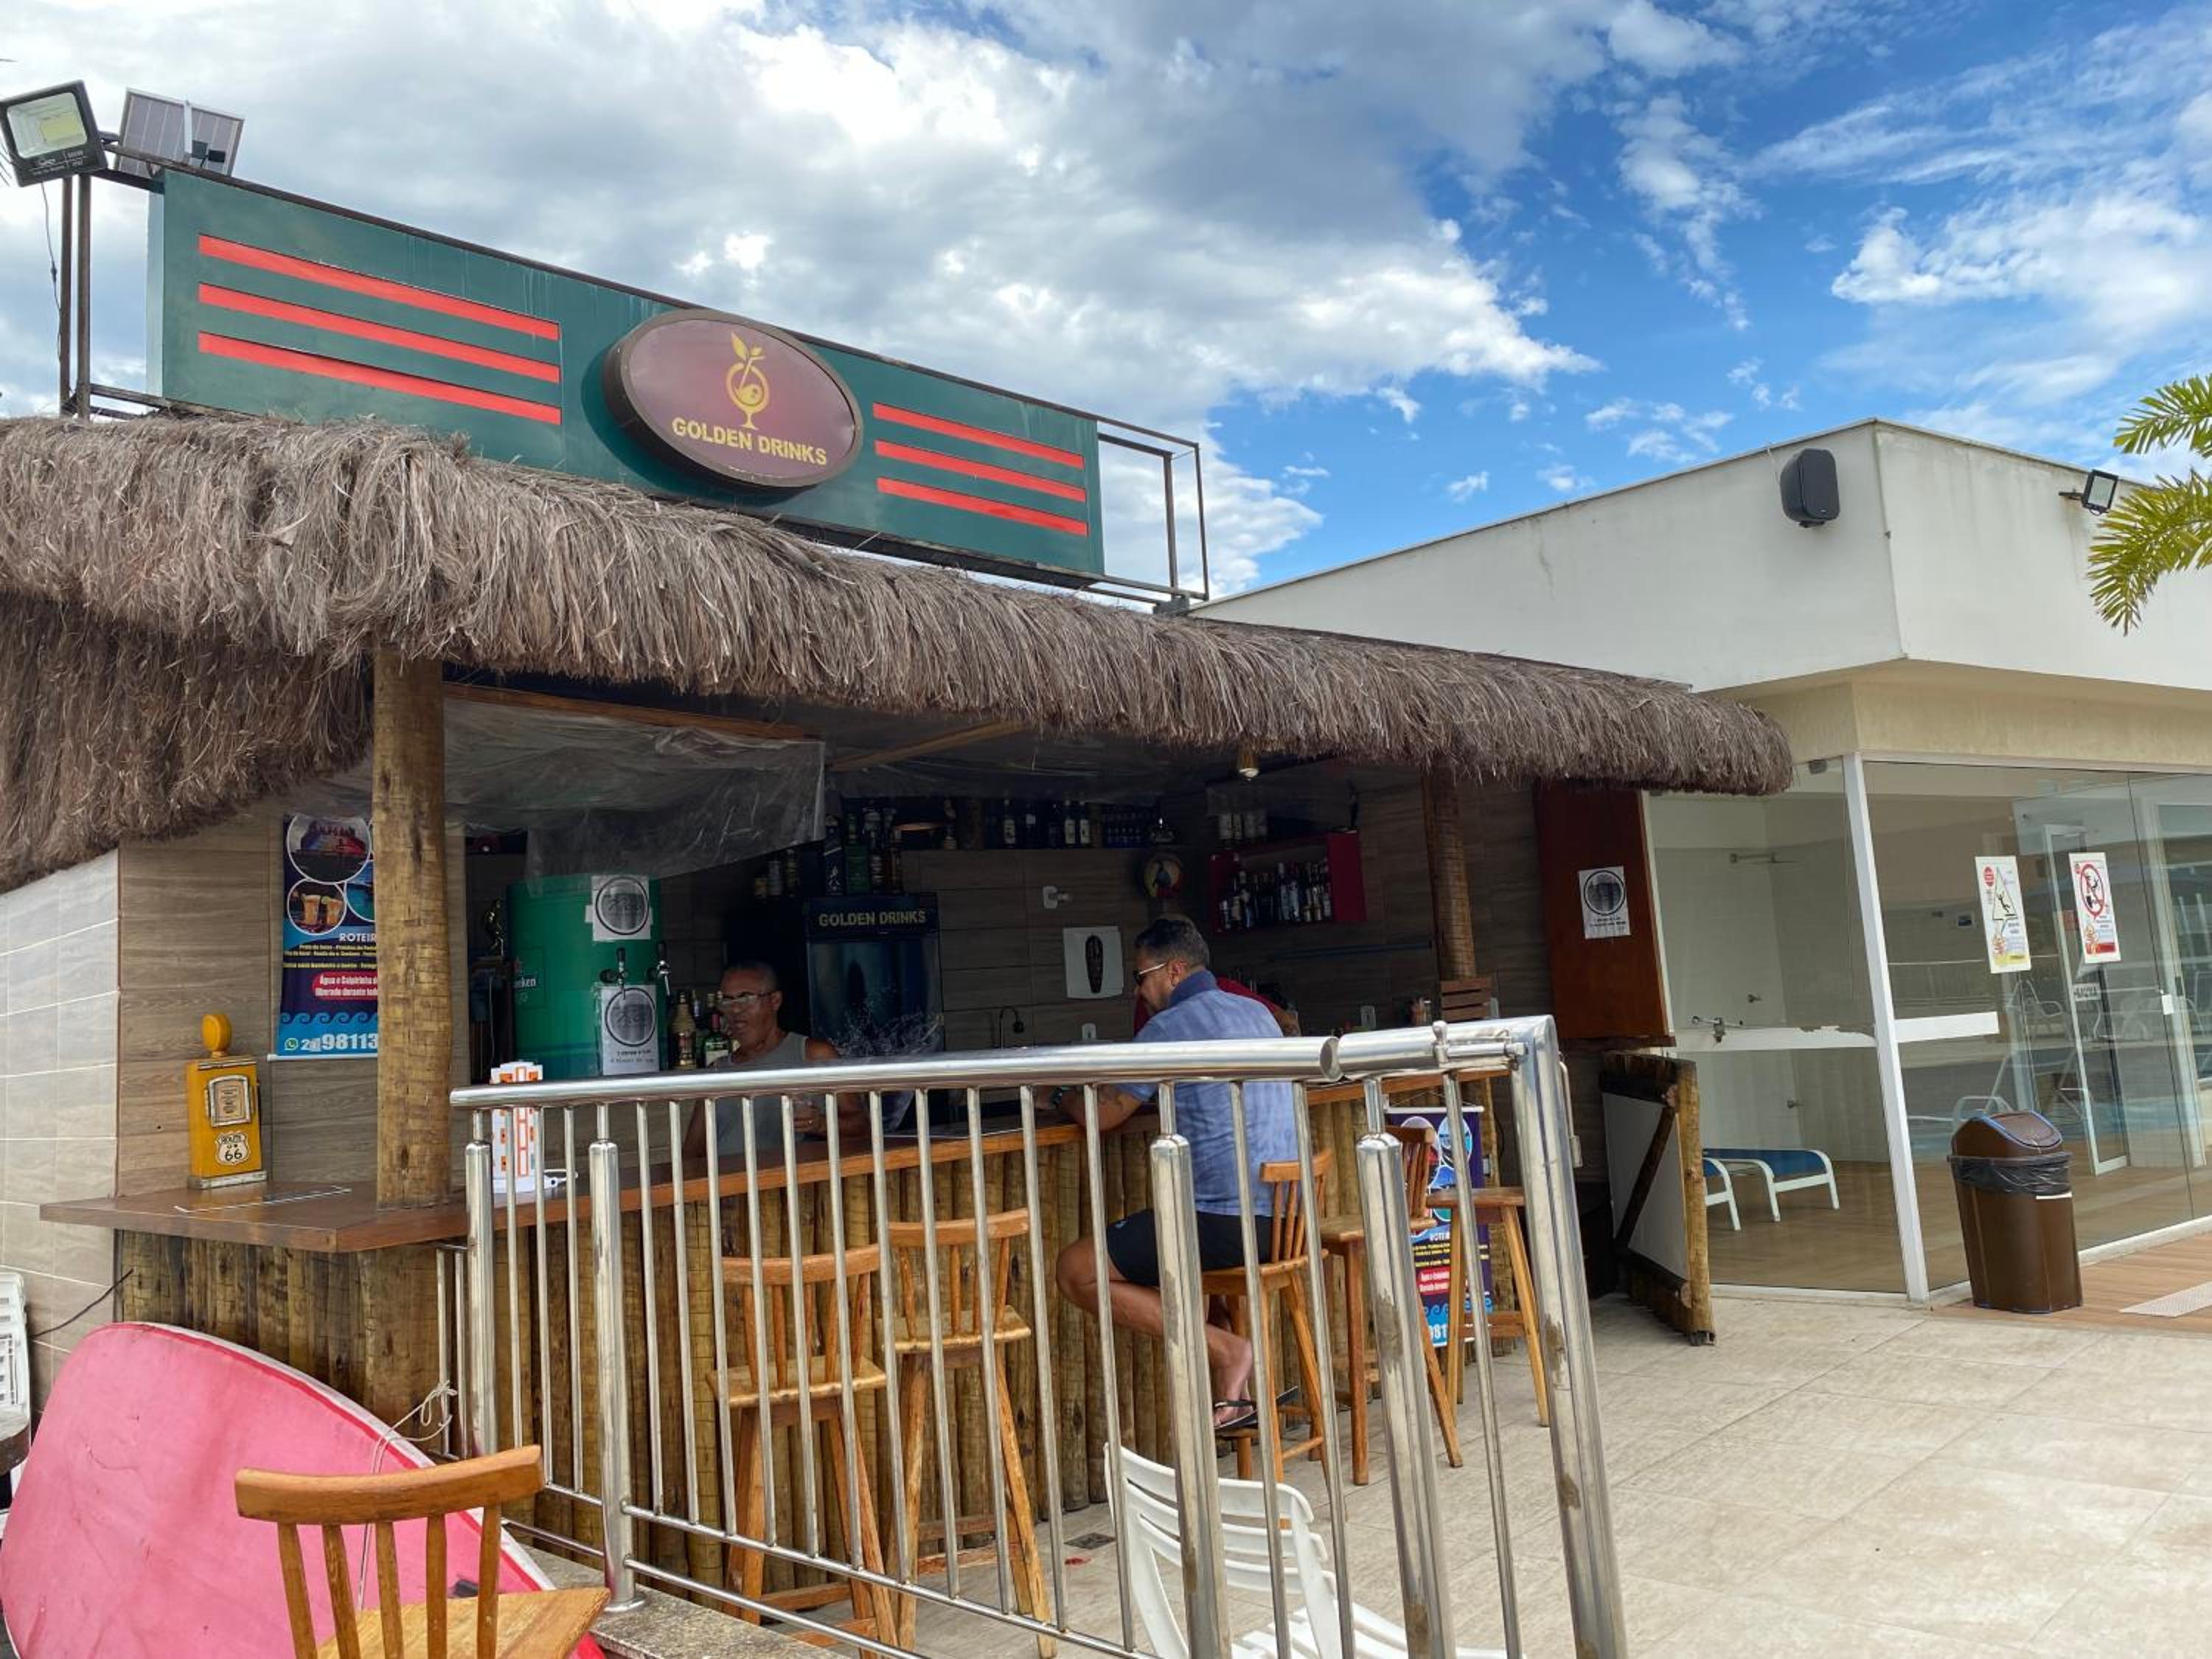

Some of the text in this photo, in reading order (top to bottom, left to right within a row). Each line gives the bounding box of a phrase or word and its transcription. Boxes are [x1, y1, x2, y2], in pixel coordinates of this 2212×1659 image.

[672, 417, 827, 466] GOLDEN DRINKS
[818, 910, 926, 927] GOLDEN DRINKS
[339, 933, 378, 942] ROTEIR
[225, 1148, 243, 1161] 66
